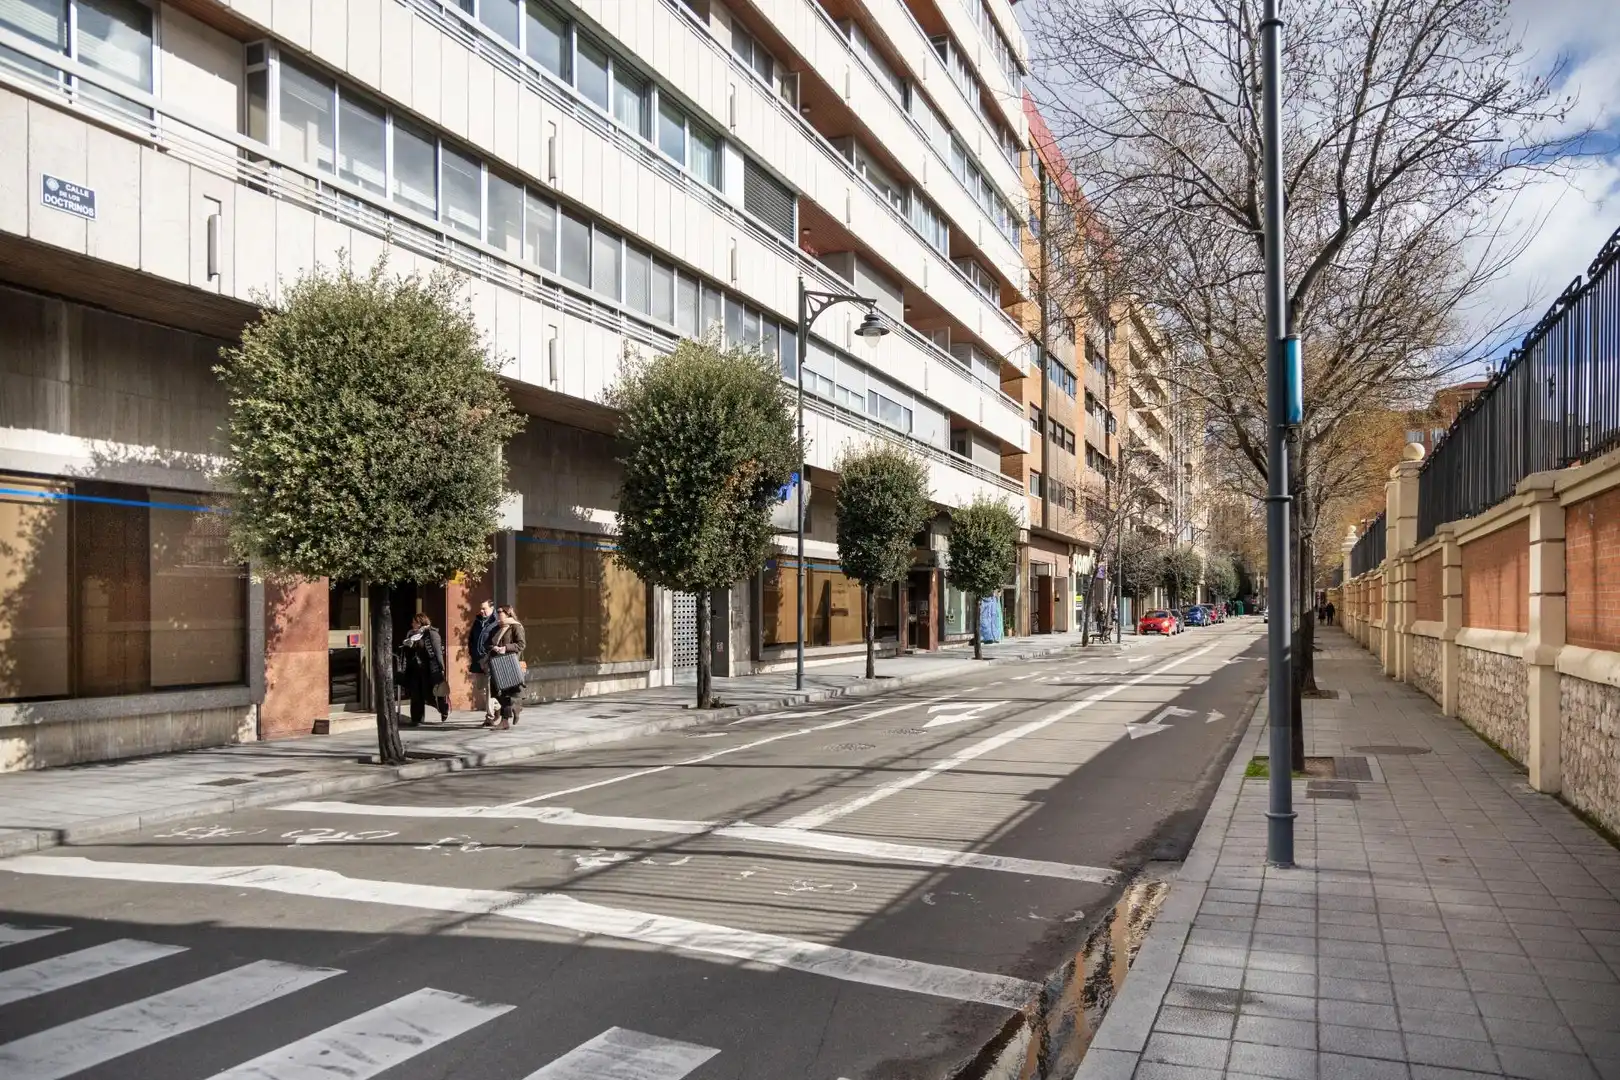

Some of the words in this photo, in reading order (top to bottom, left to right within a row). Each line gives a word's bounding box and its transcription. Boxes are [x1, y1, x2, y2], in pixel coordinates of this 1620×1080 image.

[65, 184, 89, 198] CALLE
[68, 193, 80, 202] LOS
[44, 193, 94, 216] DOCTRINOS
